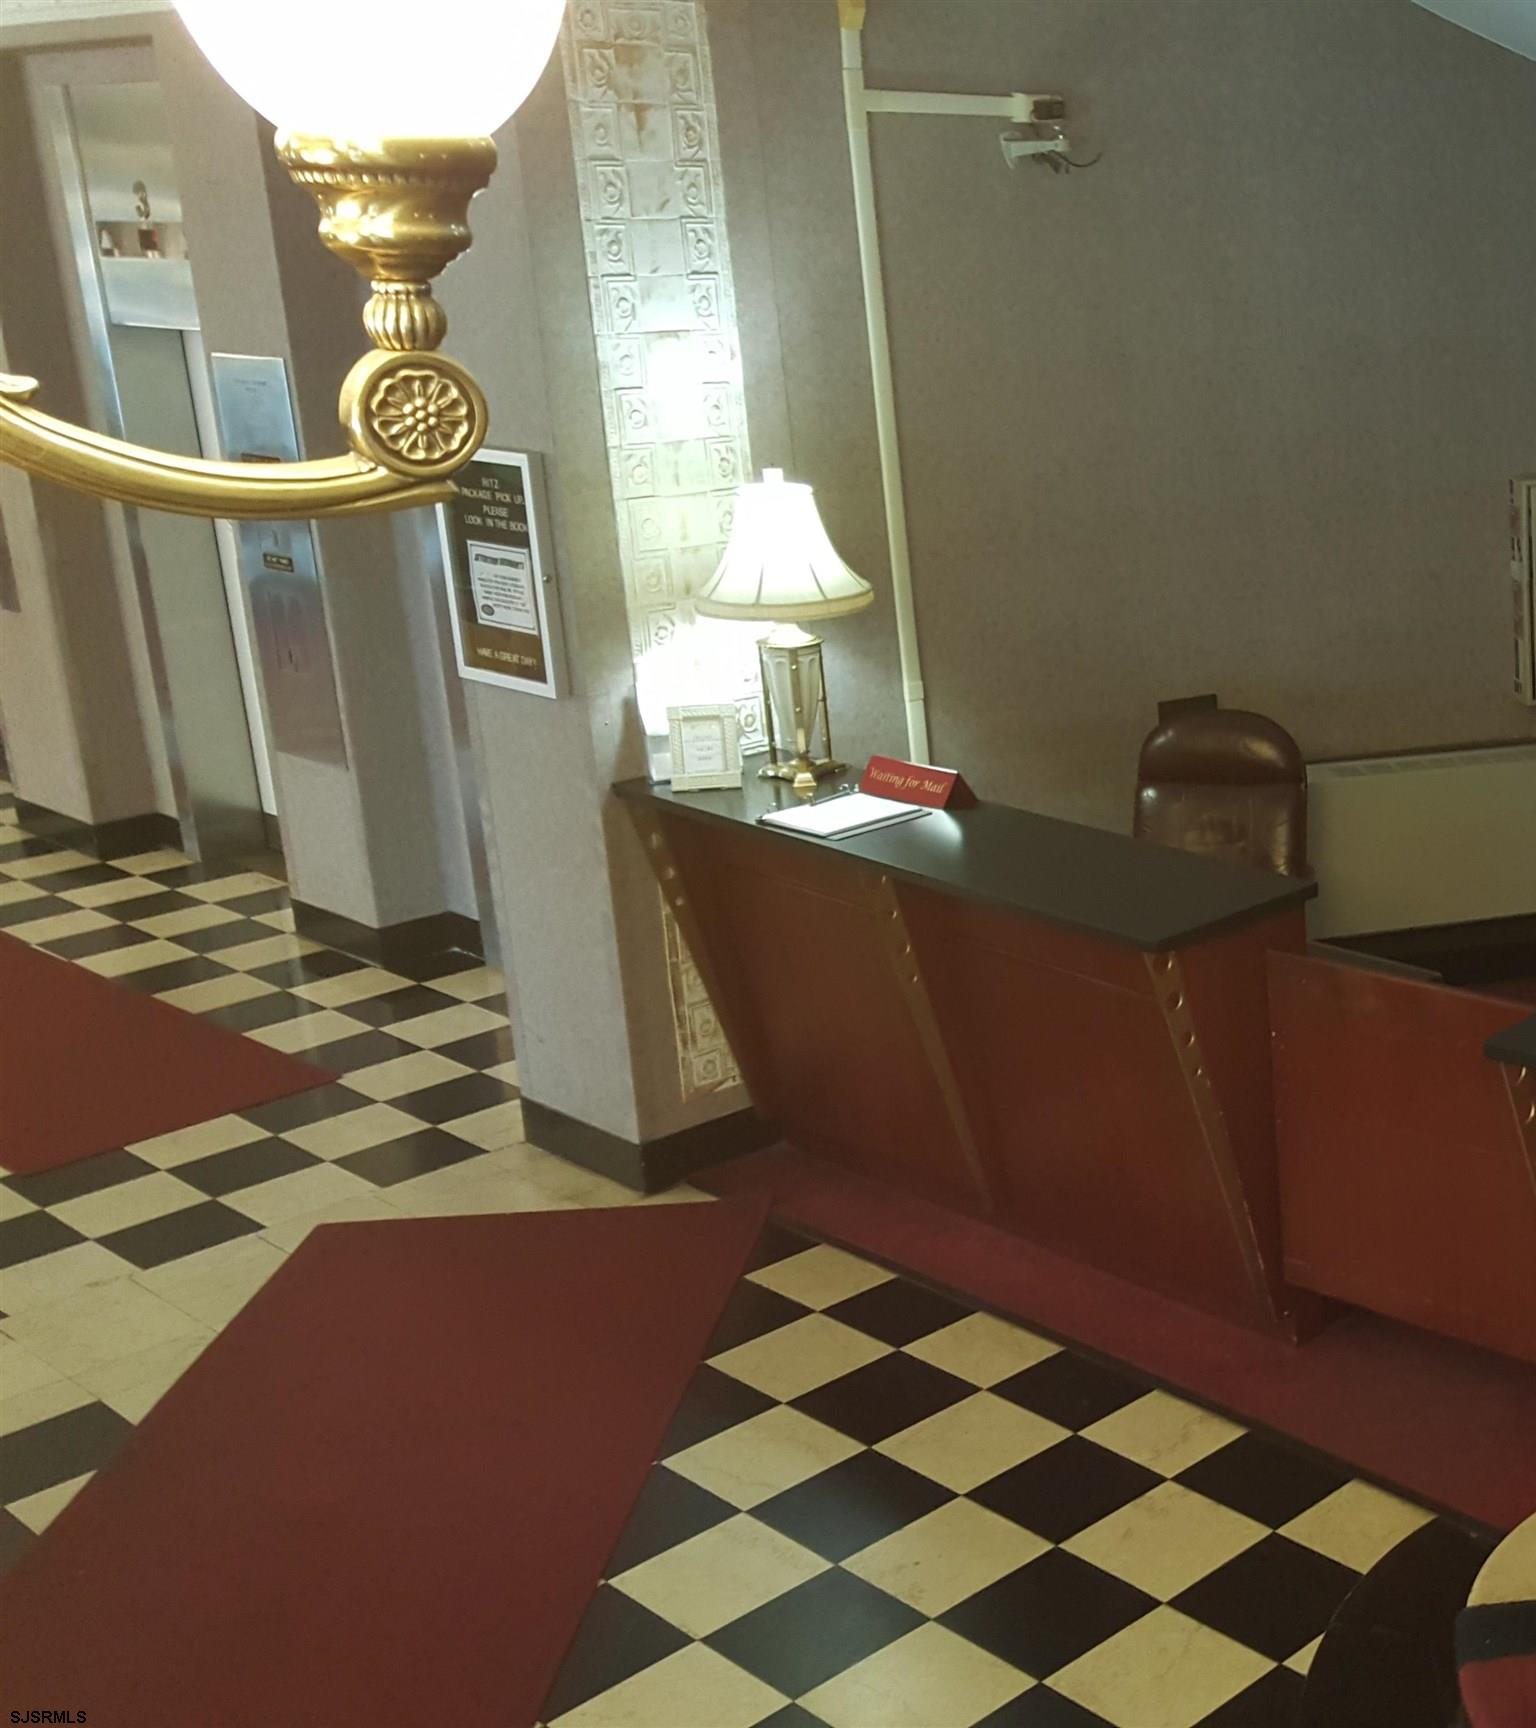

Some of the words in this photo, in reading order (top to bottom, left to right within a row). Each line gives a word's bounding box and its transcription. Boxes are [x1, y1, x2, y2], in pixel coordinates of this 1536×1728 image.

[870, 766, 903, 789] Waiting
[901, 775, 920, 790] for
[920, 780, 946, 794] Mail
